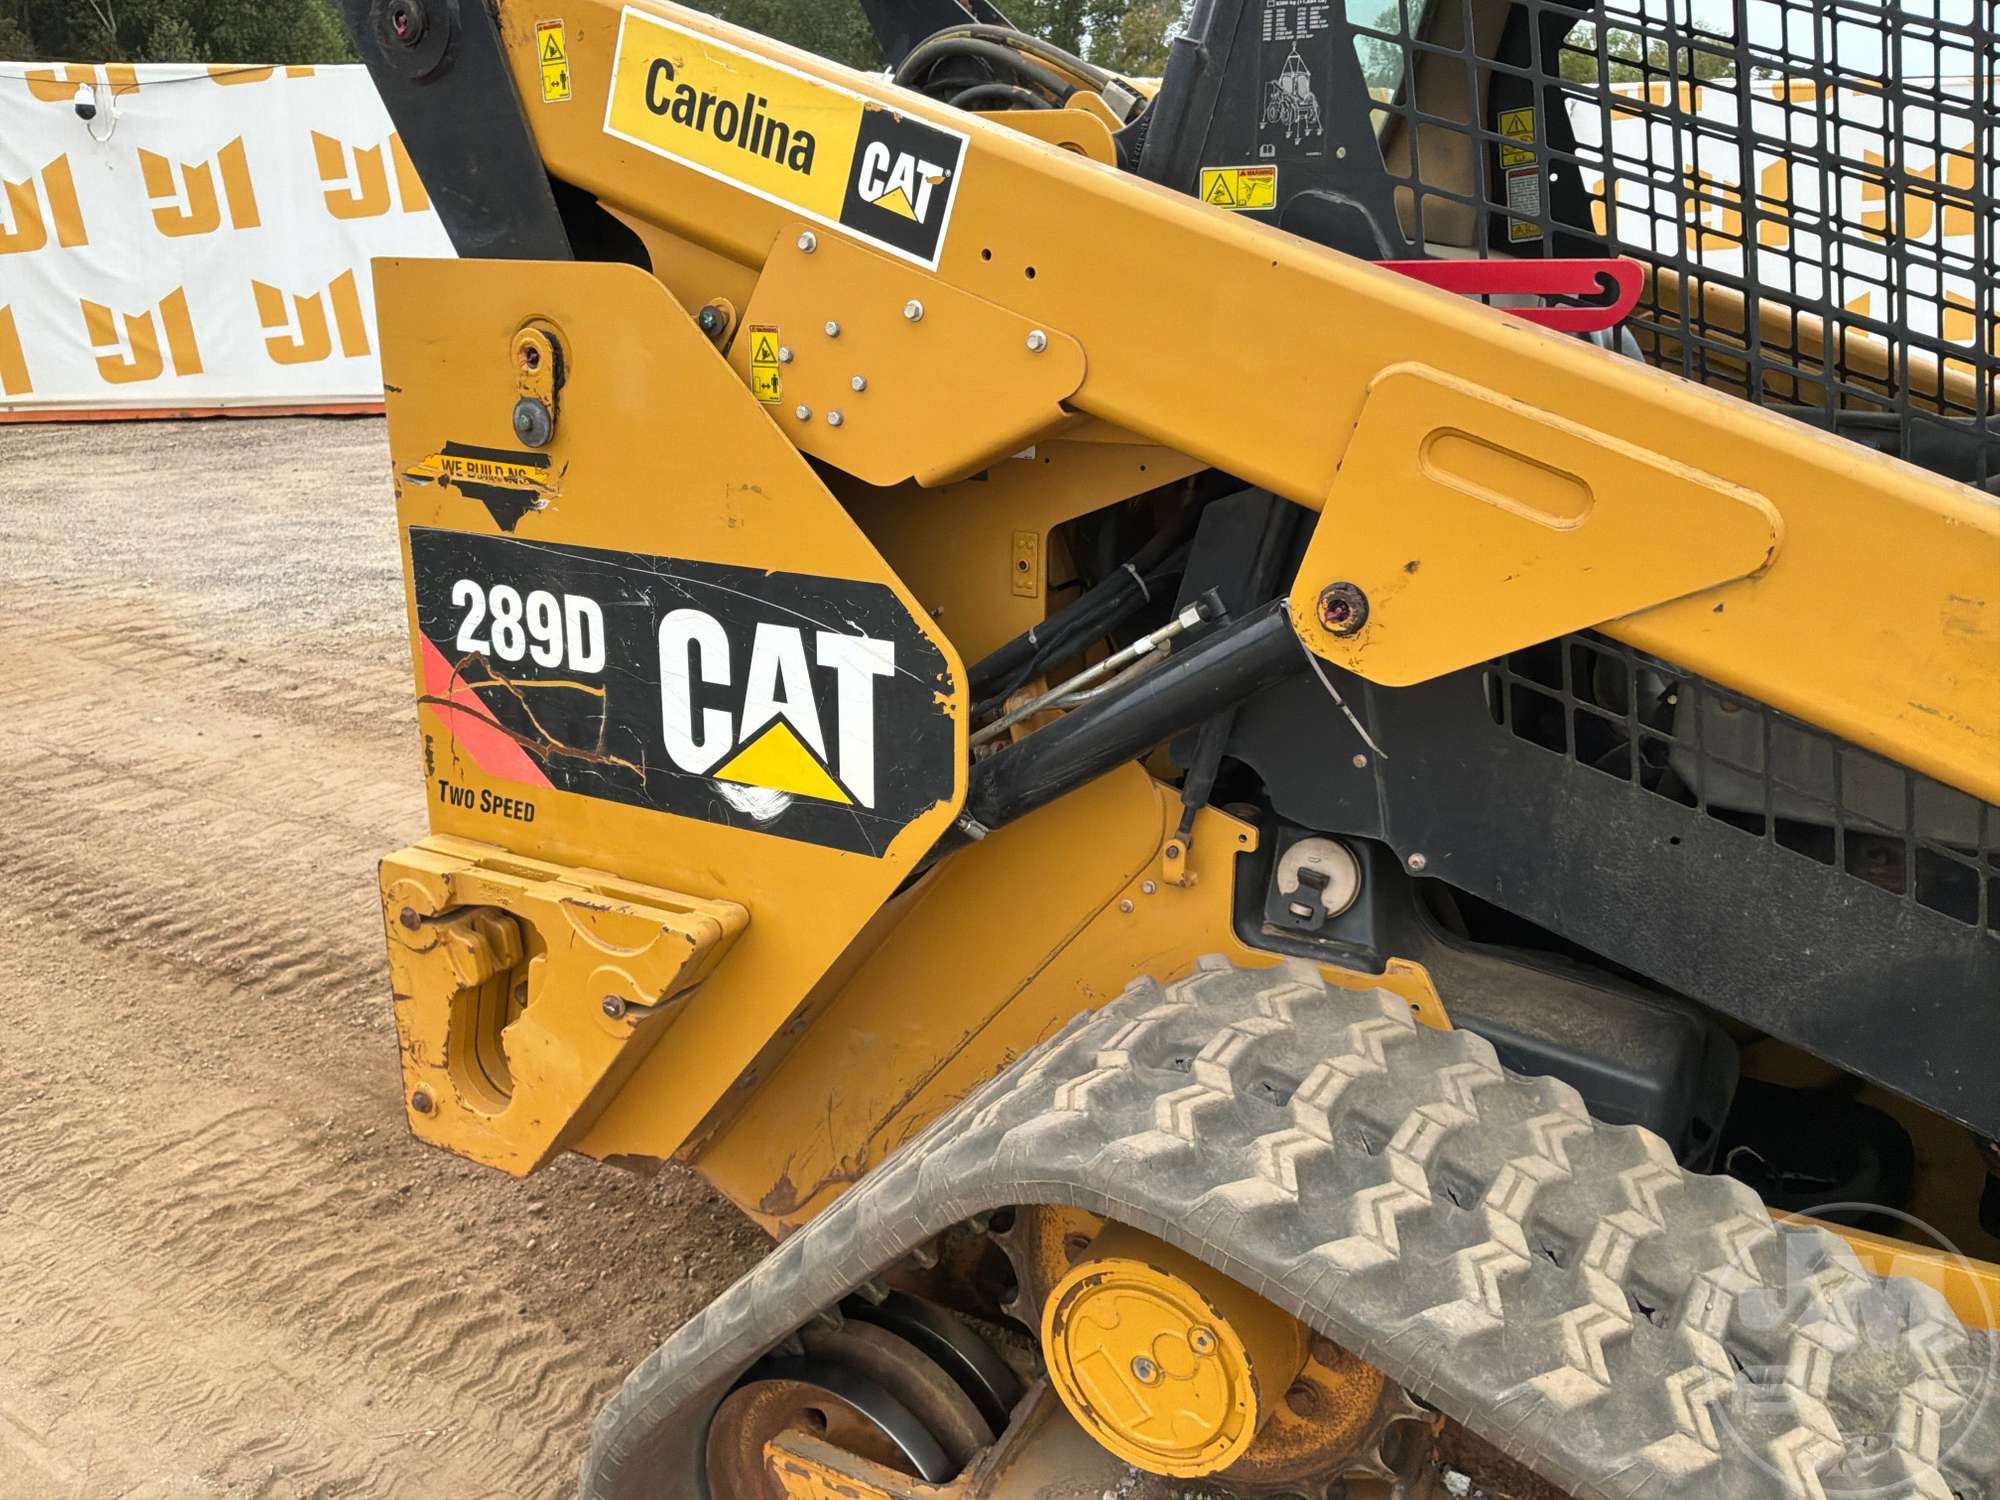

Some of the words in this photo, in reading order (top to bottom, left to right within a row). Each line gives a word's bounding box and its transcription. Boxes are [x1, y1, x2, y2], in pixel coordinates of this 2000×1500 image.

[645, 58, 816, 176] Carolina
[441, 459, 463, 477] WE
[452, 579, 606, 674] 289D
[658, 608, 895, 809] CAT
